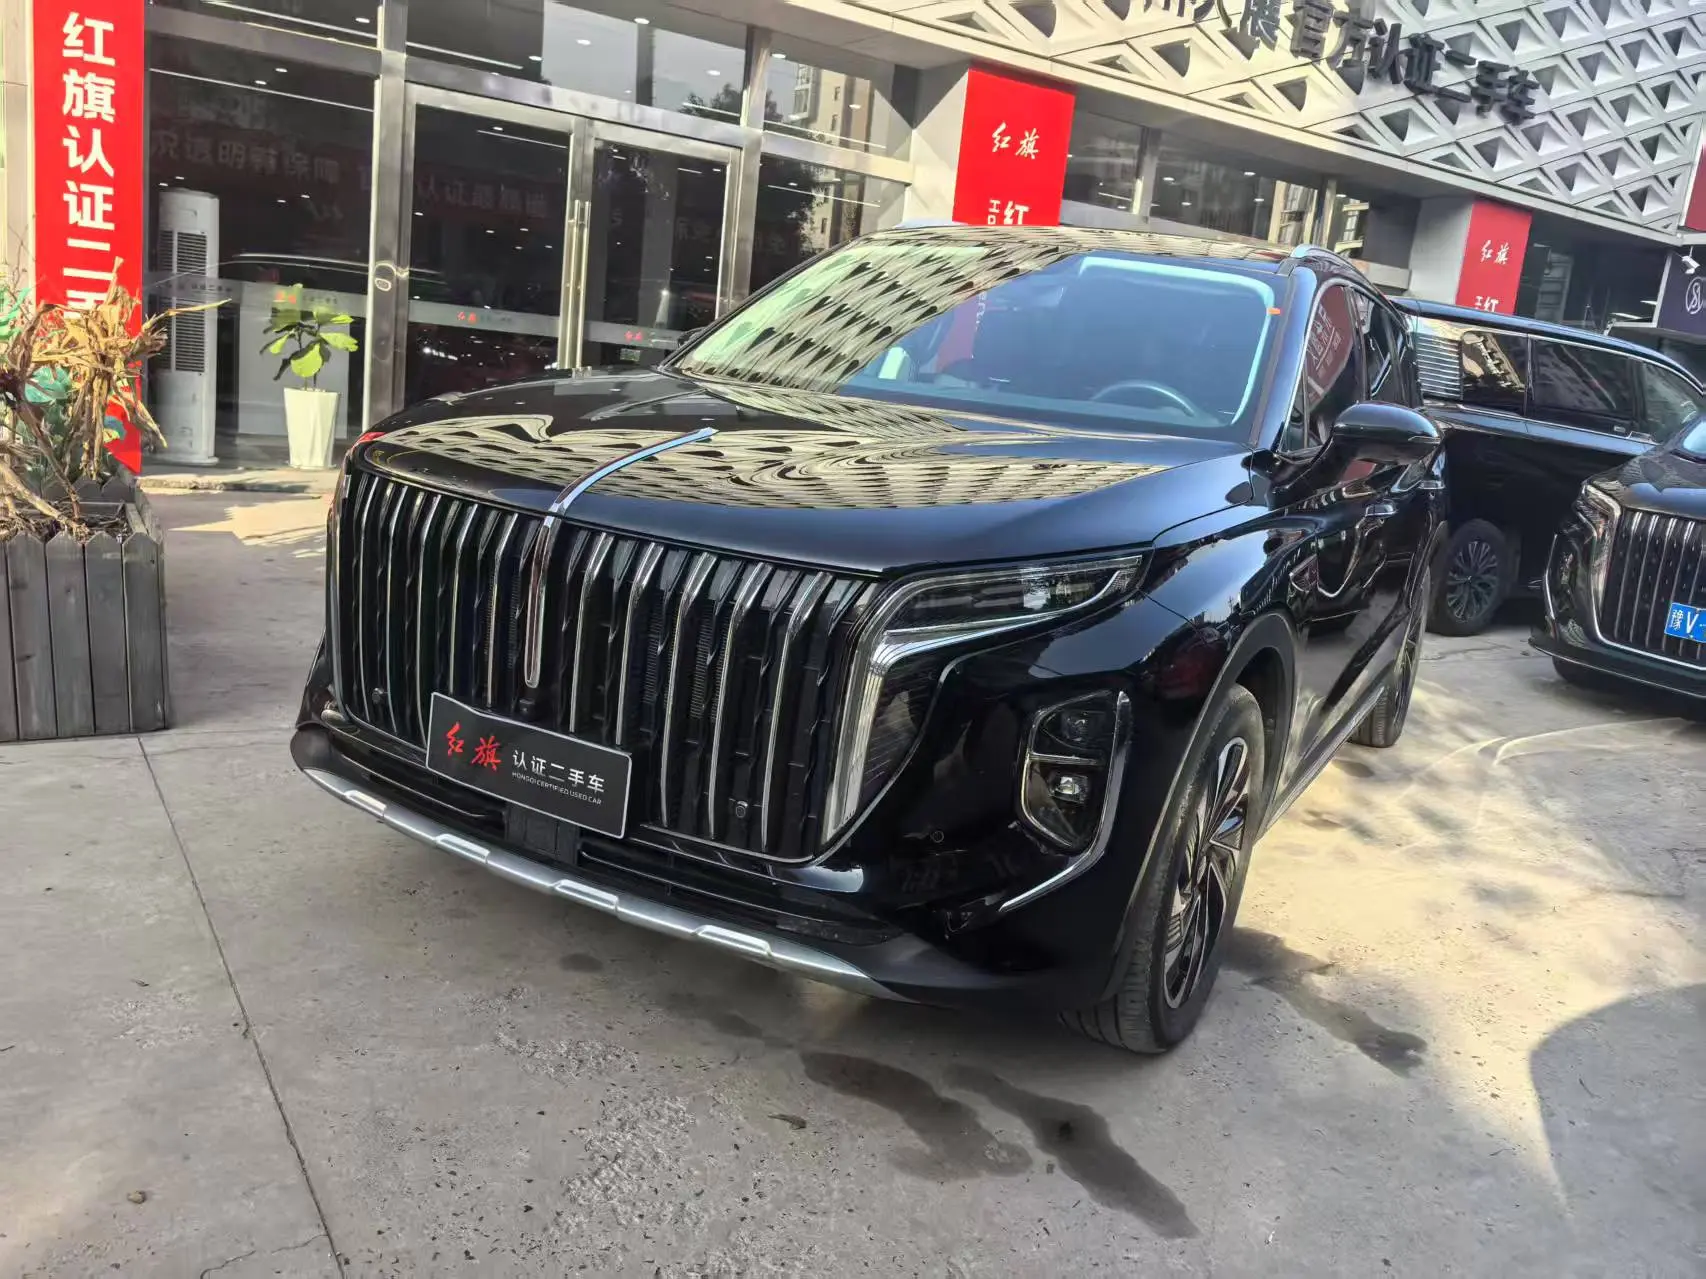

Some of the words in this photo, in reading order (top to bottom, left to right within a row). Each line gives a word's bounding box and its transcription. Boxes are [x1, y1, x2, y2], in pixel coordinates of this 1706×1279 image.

[1141, 0, 1541, 126] 展官方认证二手车
[992, 122, 1040, 160] 红旗
[1480, 239, 1510, 265] 红旗
[446, 720, 501, 771] 红旗
[511, 749, 605, 794] 认证二手车
[511, 771, 537, 785] HONGQI
[536, 780, 569, 796] CERTIFIED
[569, 790, 588, 802] USED
[588, 796, 602, 805] CAR
